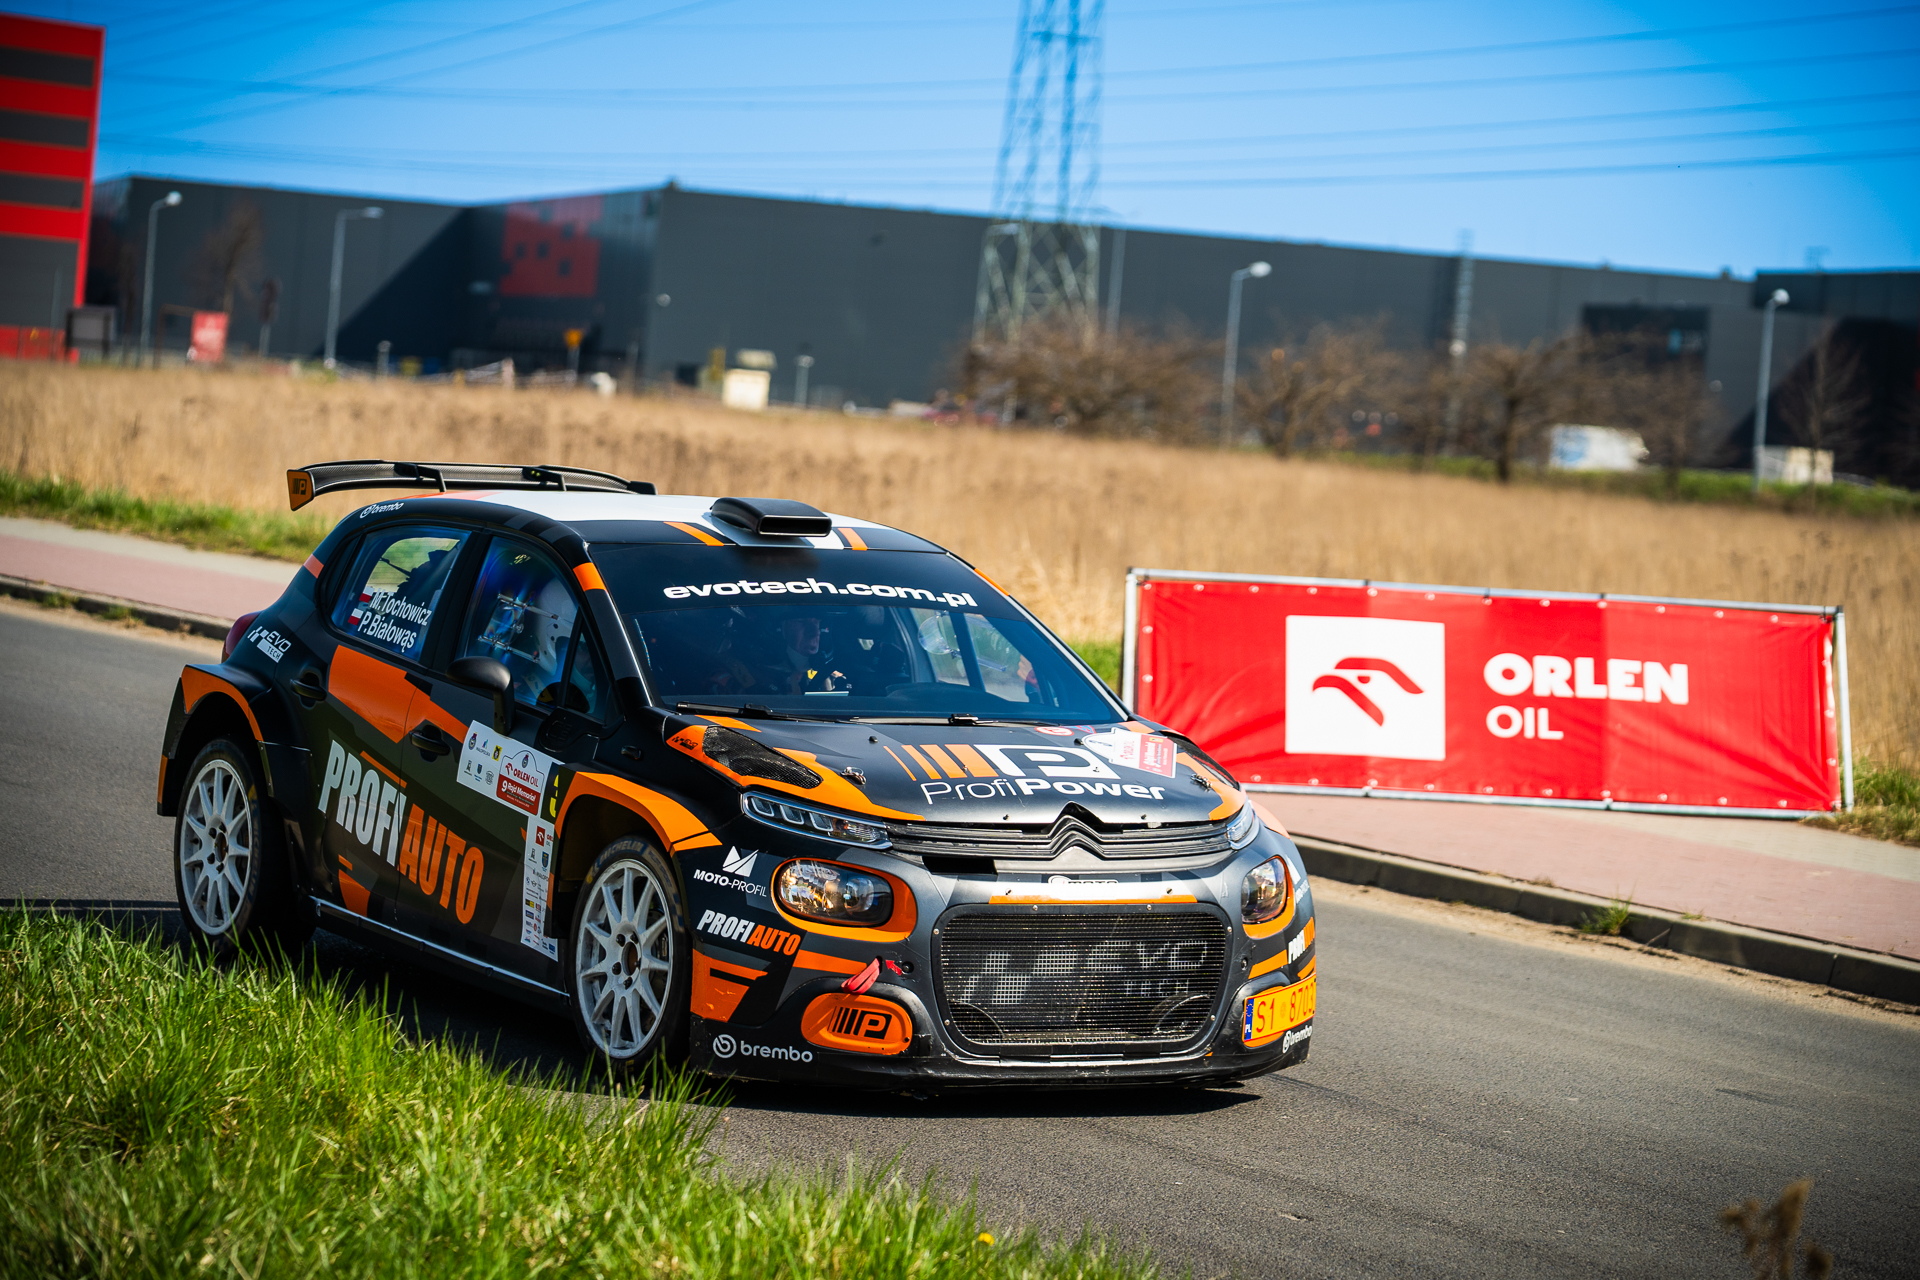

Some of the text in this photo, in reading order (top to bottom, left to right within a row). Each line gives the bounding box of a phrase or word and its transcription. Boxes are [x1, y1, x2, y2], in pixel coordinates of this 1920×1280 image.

[663, 578, 978, 607] evotech.com.pl
[266, 630, 292, 653] EVO
[357, 610, 417, 653] P.Białowąs
[1483, 652, 1689, 705] ORLEN
[1485, 705, 1564, 740] OIL
[501, 780, 508, 792] 9
[513, 768, 539, 788] ORLEN OIL
[920, 778, 1166, 805] ProfiPower
[318, 739, 484, 924] PROFIAUTO
[600, 840, 644, 862] MICHELIN
[693, 869, 768, 898] MOTO-PROFIL
[696, 909, 802, 956] PROFIAUTO
[1244, 1023, 1252, 1034] PL
[1255, 997, 1276, 1034] S1
[740, 1040, 813, 1063] brembo
